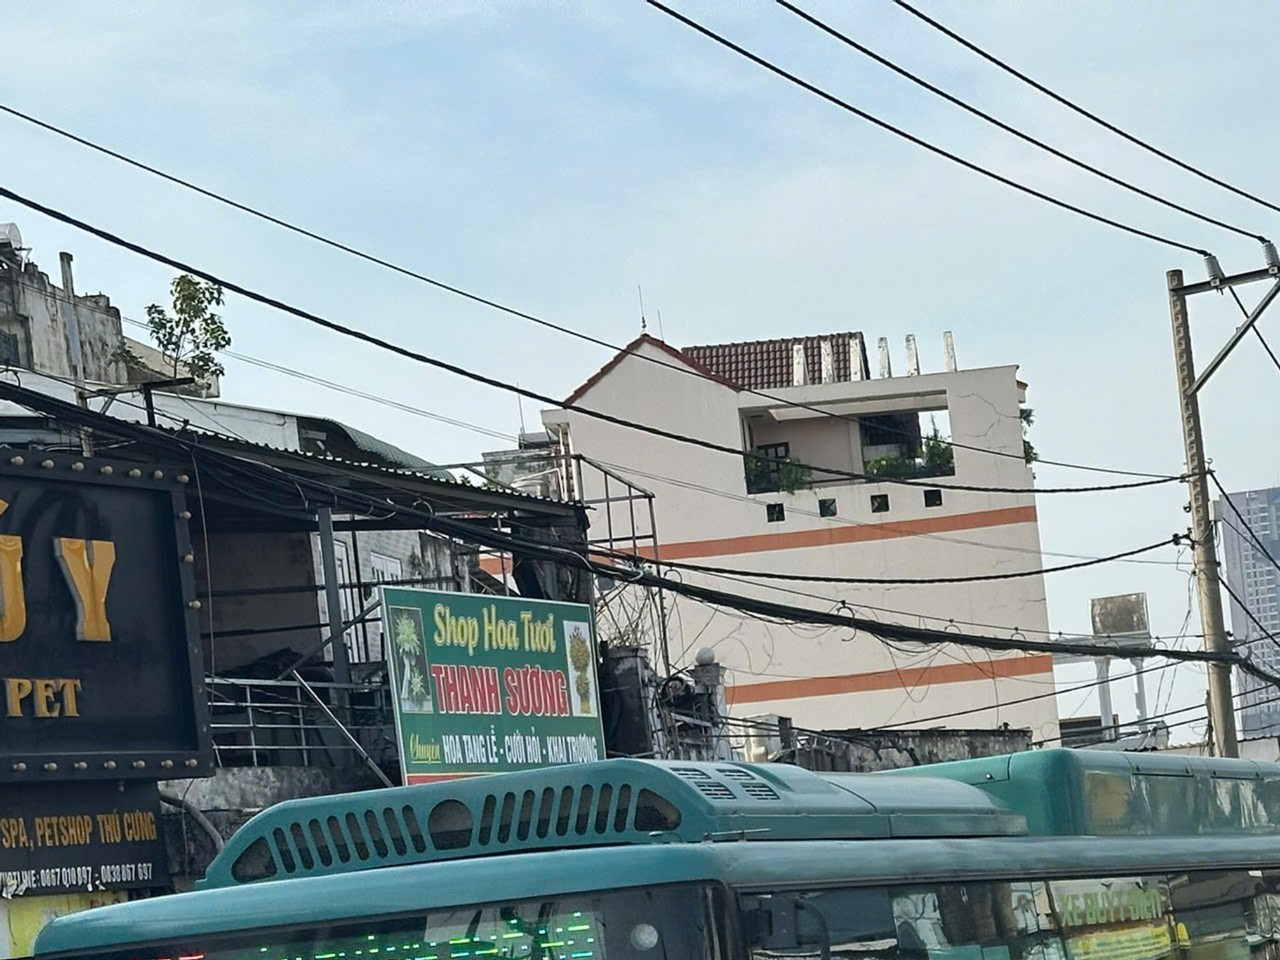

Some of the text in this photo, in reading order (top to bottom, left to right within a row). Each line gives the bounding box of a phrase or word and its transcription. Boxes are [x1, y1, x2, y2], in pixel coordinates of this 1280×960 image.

[433, 603, 557, 656] Shop Hoa Tươi
[4, 677, 83, 718] PET
[431, 663, 570, 718] THANH SƯƠNG
[442, 734, 463, 765] HOA
[462, 734, 487, 765] TANG
[546, 734, 568, 765] KHAI
[34, 815, 93, 848] PETSHOP
